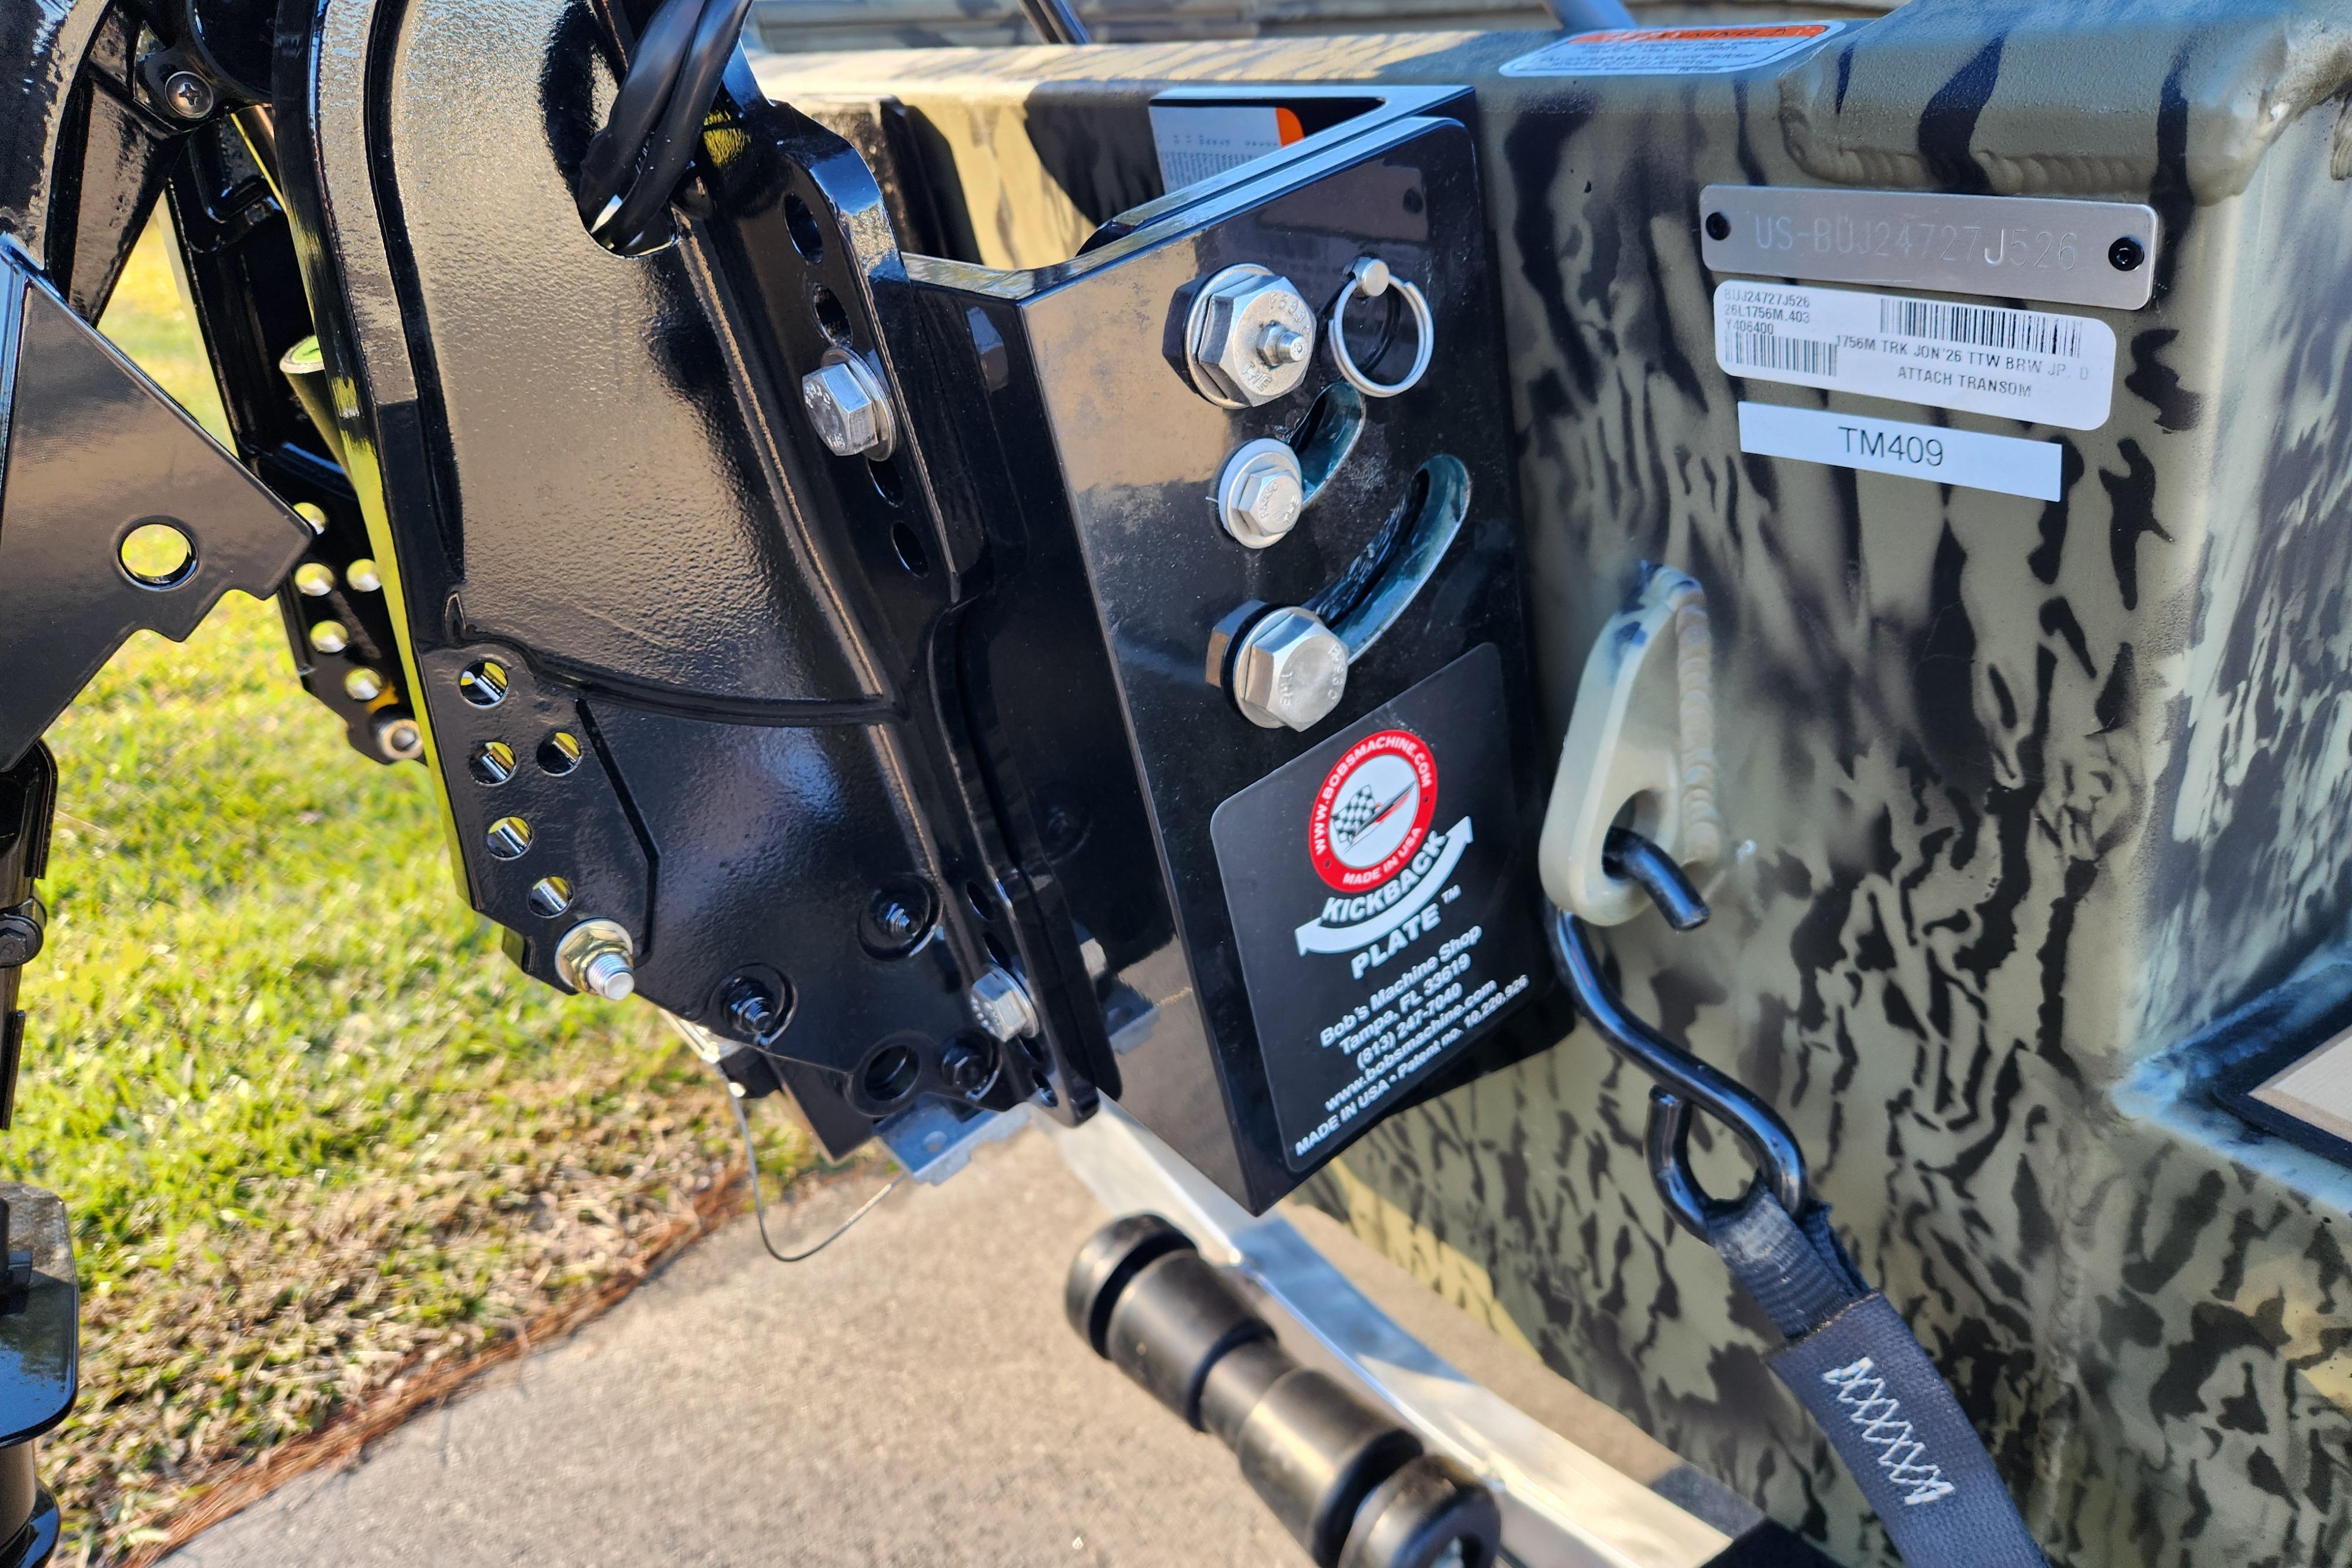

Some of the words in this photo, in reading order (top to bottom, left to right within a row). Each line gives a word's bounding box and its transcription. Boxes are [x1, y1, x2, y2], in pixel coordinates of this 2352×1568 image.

[1755, 215, 2077, 271] US-BUJ24727J526
[1724, 304, 1810, 323] 26L1756M.403
[1725, 319, 1773, 335] Y406400
[1836, 335, 1876, 351] 1756M
[1882, 340, 1908, 355] TRK
[1967, 352, 2000, 367] TTW
[2006, 357, 2043, 374] BRW
[1898, 366, 1952, 386] ATTACH
[1958, 375, 2032, 397] TRANSOM
[1838, 426, 1943, 466] TM409
[1314, 735, 1433, 855] WWW.BOBSMACHINE.COM
[1322, 830, 1448, 922] KICKBACK
[1342, 868, 1381, 885] MADE
[1383, 856, 1399, 873] IN
[1398, 827, 1422, 858] USA
[1351, 903, 1441, 979] PLATE
[1320, 1005, 1371, 1048] Bob's
[1370, 956, 1439, 1012] Machine
[1439, 925, 1482, 962] Shop
[1339, 1010, 1401, 1055] Tampa,
[1399, 989, 1424, 1014] FL
[1424, 953, 1471, 997] 33619
[1325, 980, 1497, 1112] www.bobsmachine.com
[1357, 1031, 1396, 1071] (813)
[1396, 982, 1463, 1040] 247-7040
[1295, 1114, 1341, 1157] MADE
[1339, 1101, 1358, 1123] IN
[1358, 1079, 1391, 1109] USA
[1397, 1040, 1442, 1079] Patent
[1441, 1028, 1464, 1048] no.
[1464, 974, 1529, 1029] 10,220,926
